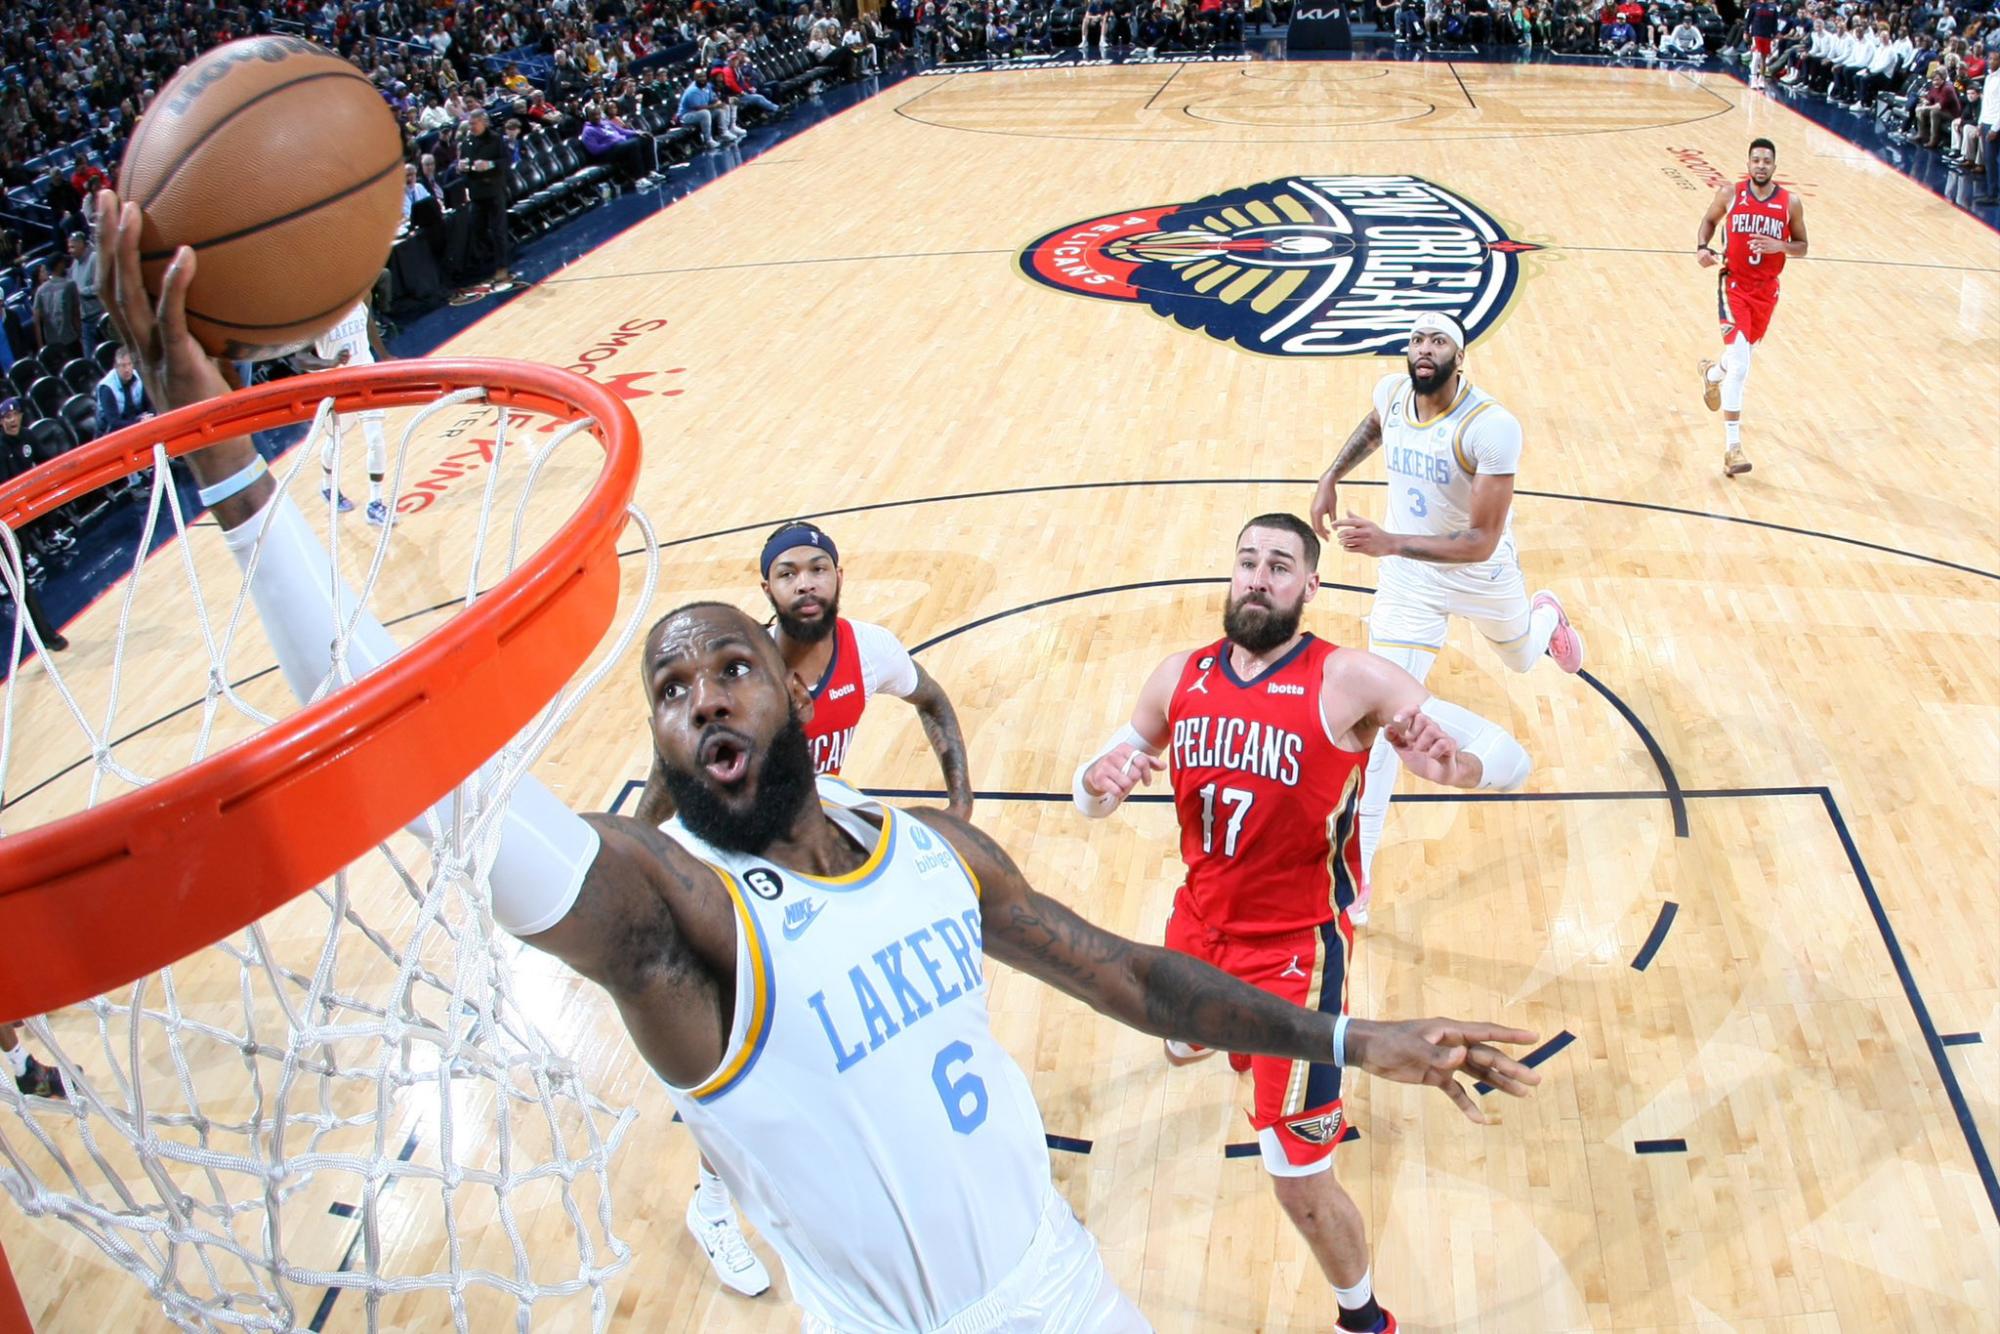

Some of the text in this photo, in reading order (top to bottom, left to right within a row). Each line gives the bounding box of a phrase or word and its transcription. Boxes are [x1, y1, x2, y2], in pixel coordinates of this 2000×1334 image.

[919, 54, 1253, 76] NEW ORLEANS PELICANS
[1731, 213, 1785, 240] PELICANS
[1053, 216, 1146, 285] PELICANS
[1281, 175, 1484, 353] NEW ORLEANS
[328, 318, 366, 341] LAKERS
[1386, 446, 1450, 485] LAKERS
[1407, 487, 1428, 518] 3
[1198, 656, 1214, 670] 6
[1173, 716, 1303, 787] PELICANS
[1199, 783, 1255, 857] 17
[914, 850, 952, 874] bibigo
[748, 871, 778, 898] 6
[783, 896, 819, 926] NIKE
[931, 1039, 989, 1135] 6
